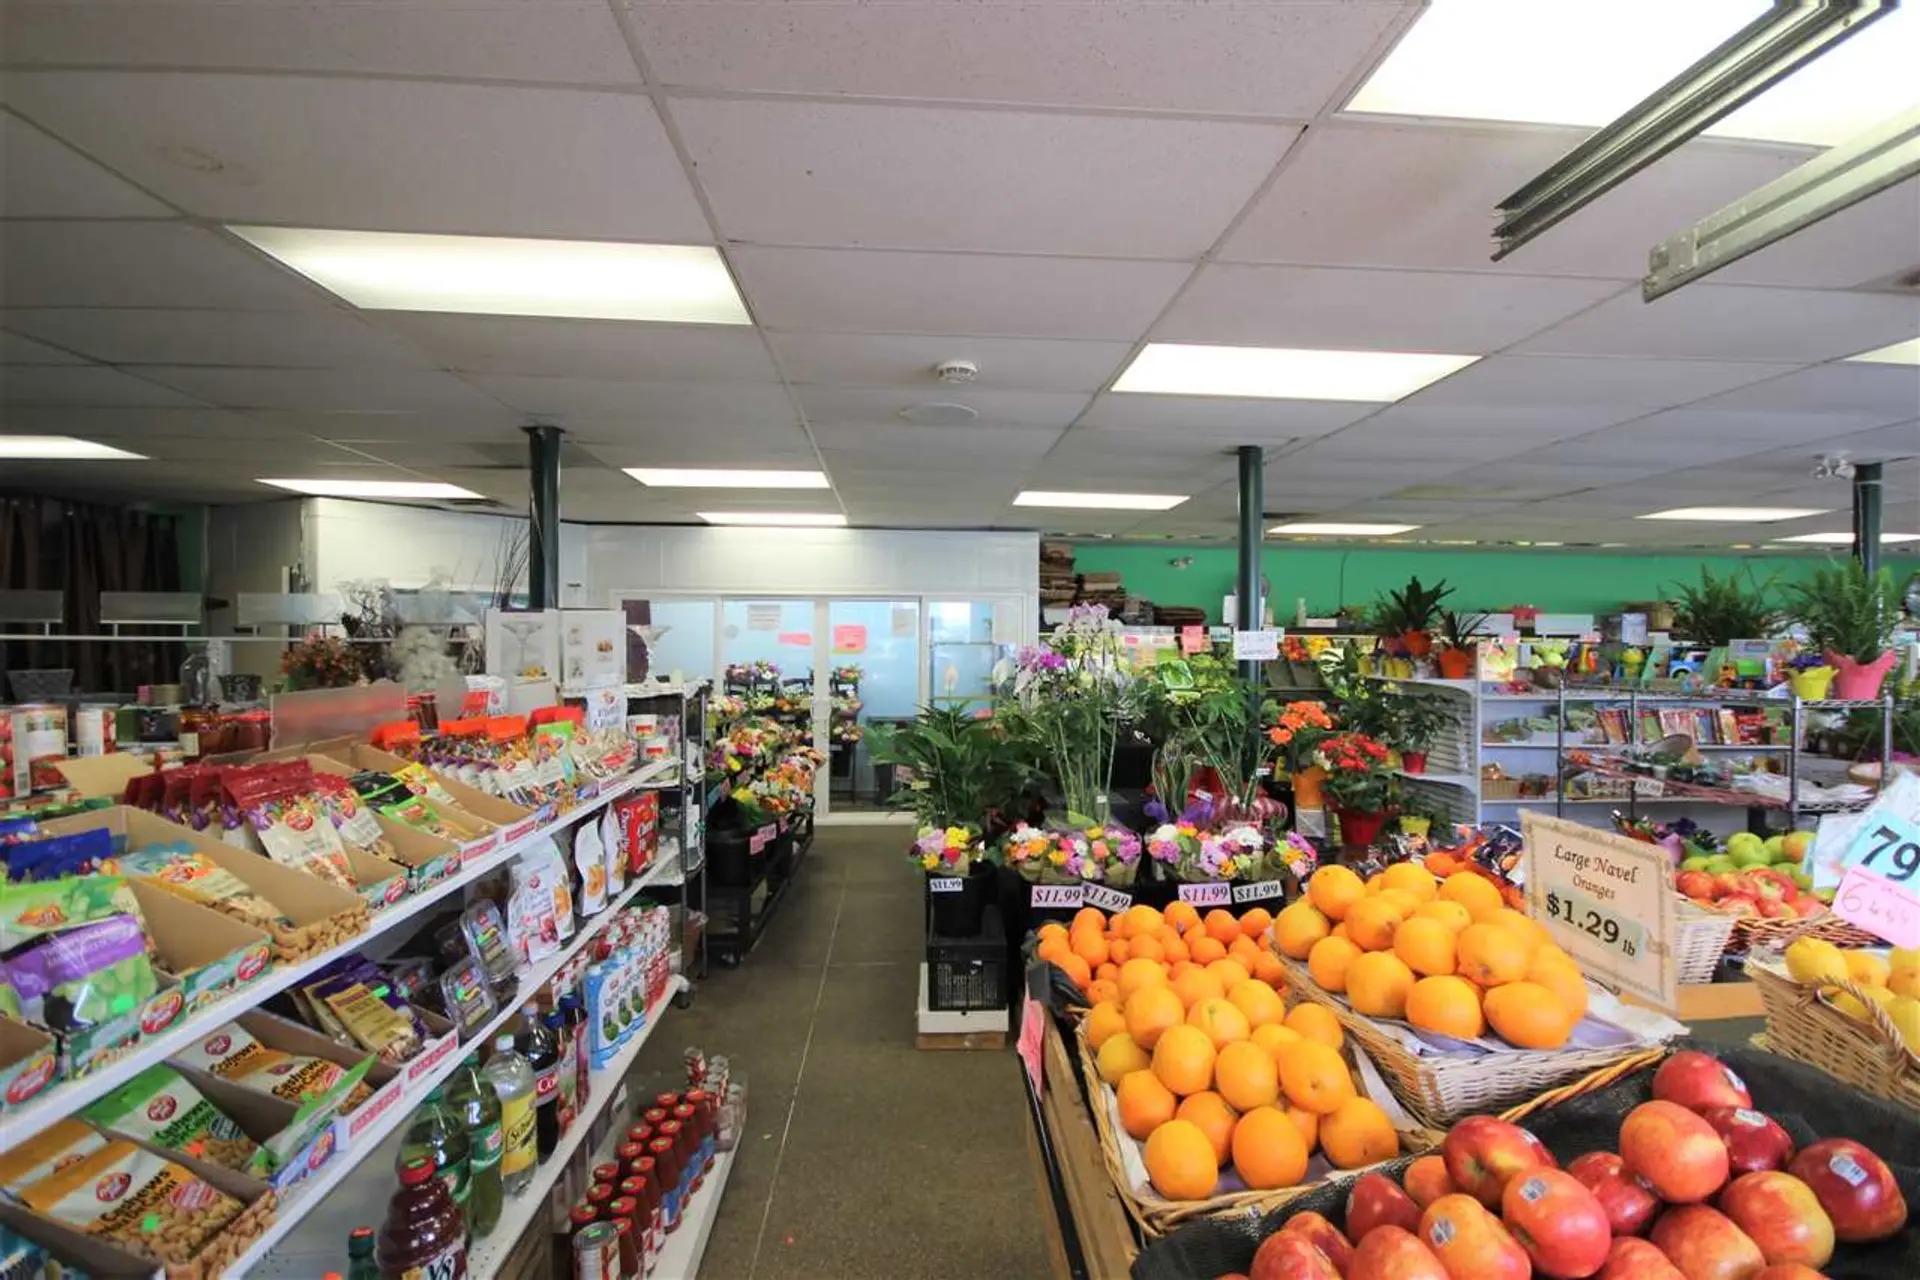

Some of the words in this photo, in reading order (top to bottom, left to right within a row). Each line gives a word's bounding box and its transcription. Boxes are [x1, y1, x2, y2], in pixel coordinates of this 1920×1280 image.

[1554, 845, 1590, 872] Large
[1593, 857, 1639, 883] Navel
[1034, 887, 1081, 904] $11.99
[1082, 884, 1129, 909] $11.99
[1183, 886, 1228, 902] $11.99
[1237, 883, 1279, 900] $11.99
[1572, 874, 1615, 900] Oranges
[1546, 892, 1619, 944] $1.29
[1622, 934, 1636, 956] lb
[271, 1059, 324, 1095] Cashews
[100, 1169, 171, 1222] Cashews
